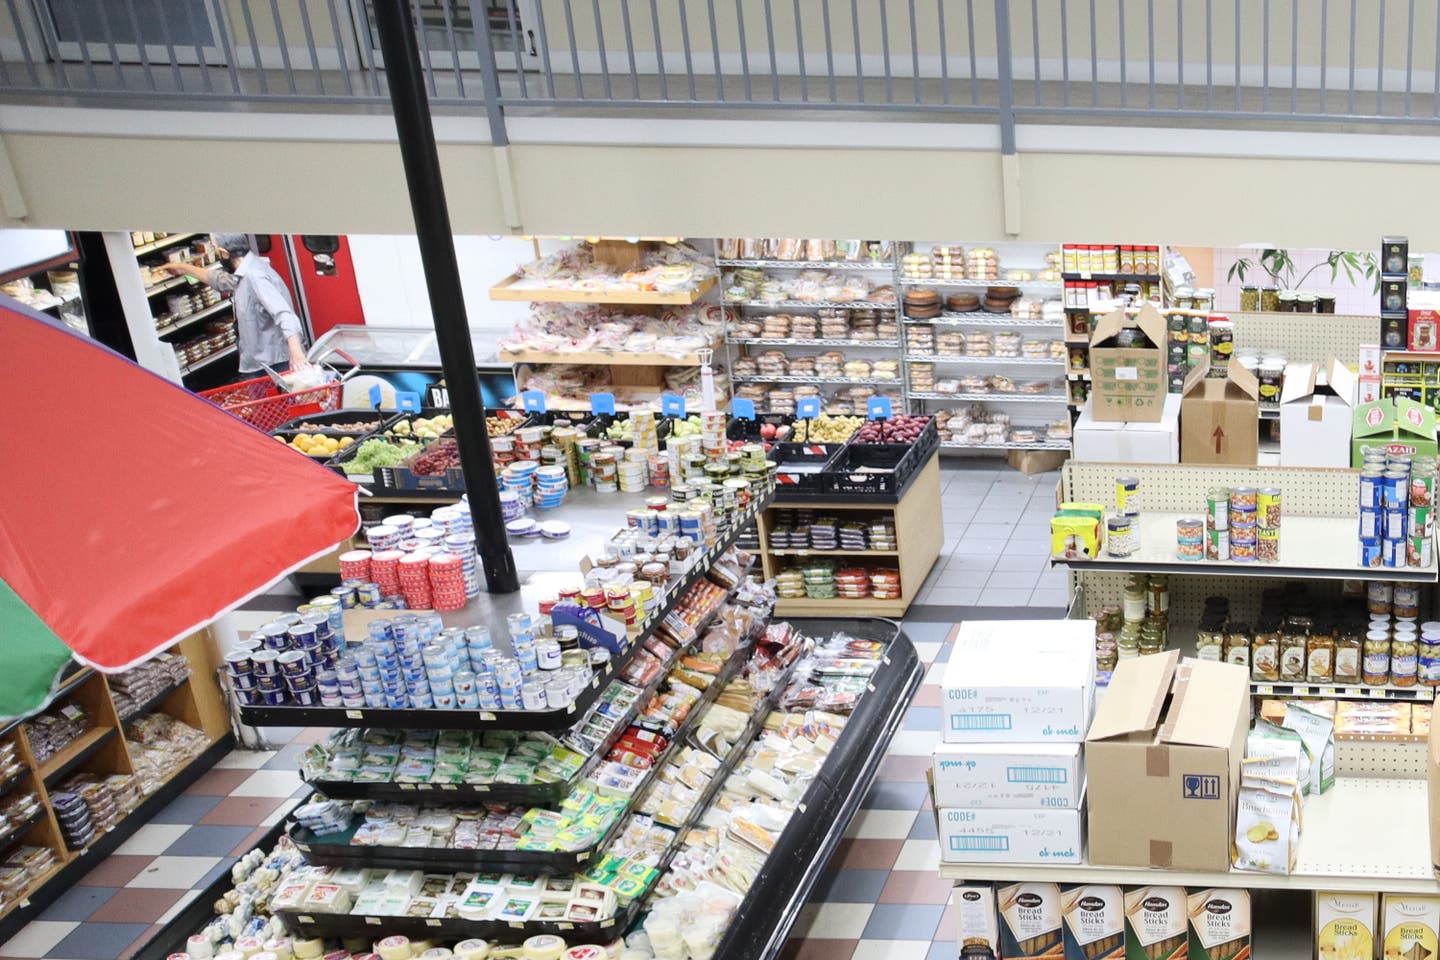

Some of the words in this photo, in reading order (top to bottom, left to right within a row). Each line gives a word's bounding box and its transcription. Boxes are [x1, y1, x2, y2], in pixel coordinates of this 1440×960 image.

[1386, 446, 1416, 455] AZAH
[949, 689, 977, 700] CODE#
[947, 811, 976, 822] CODE#
[1144, 911, 1168, 919] Bread
